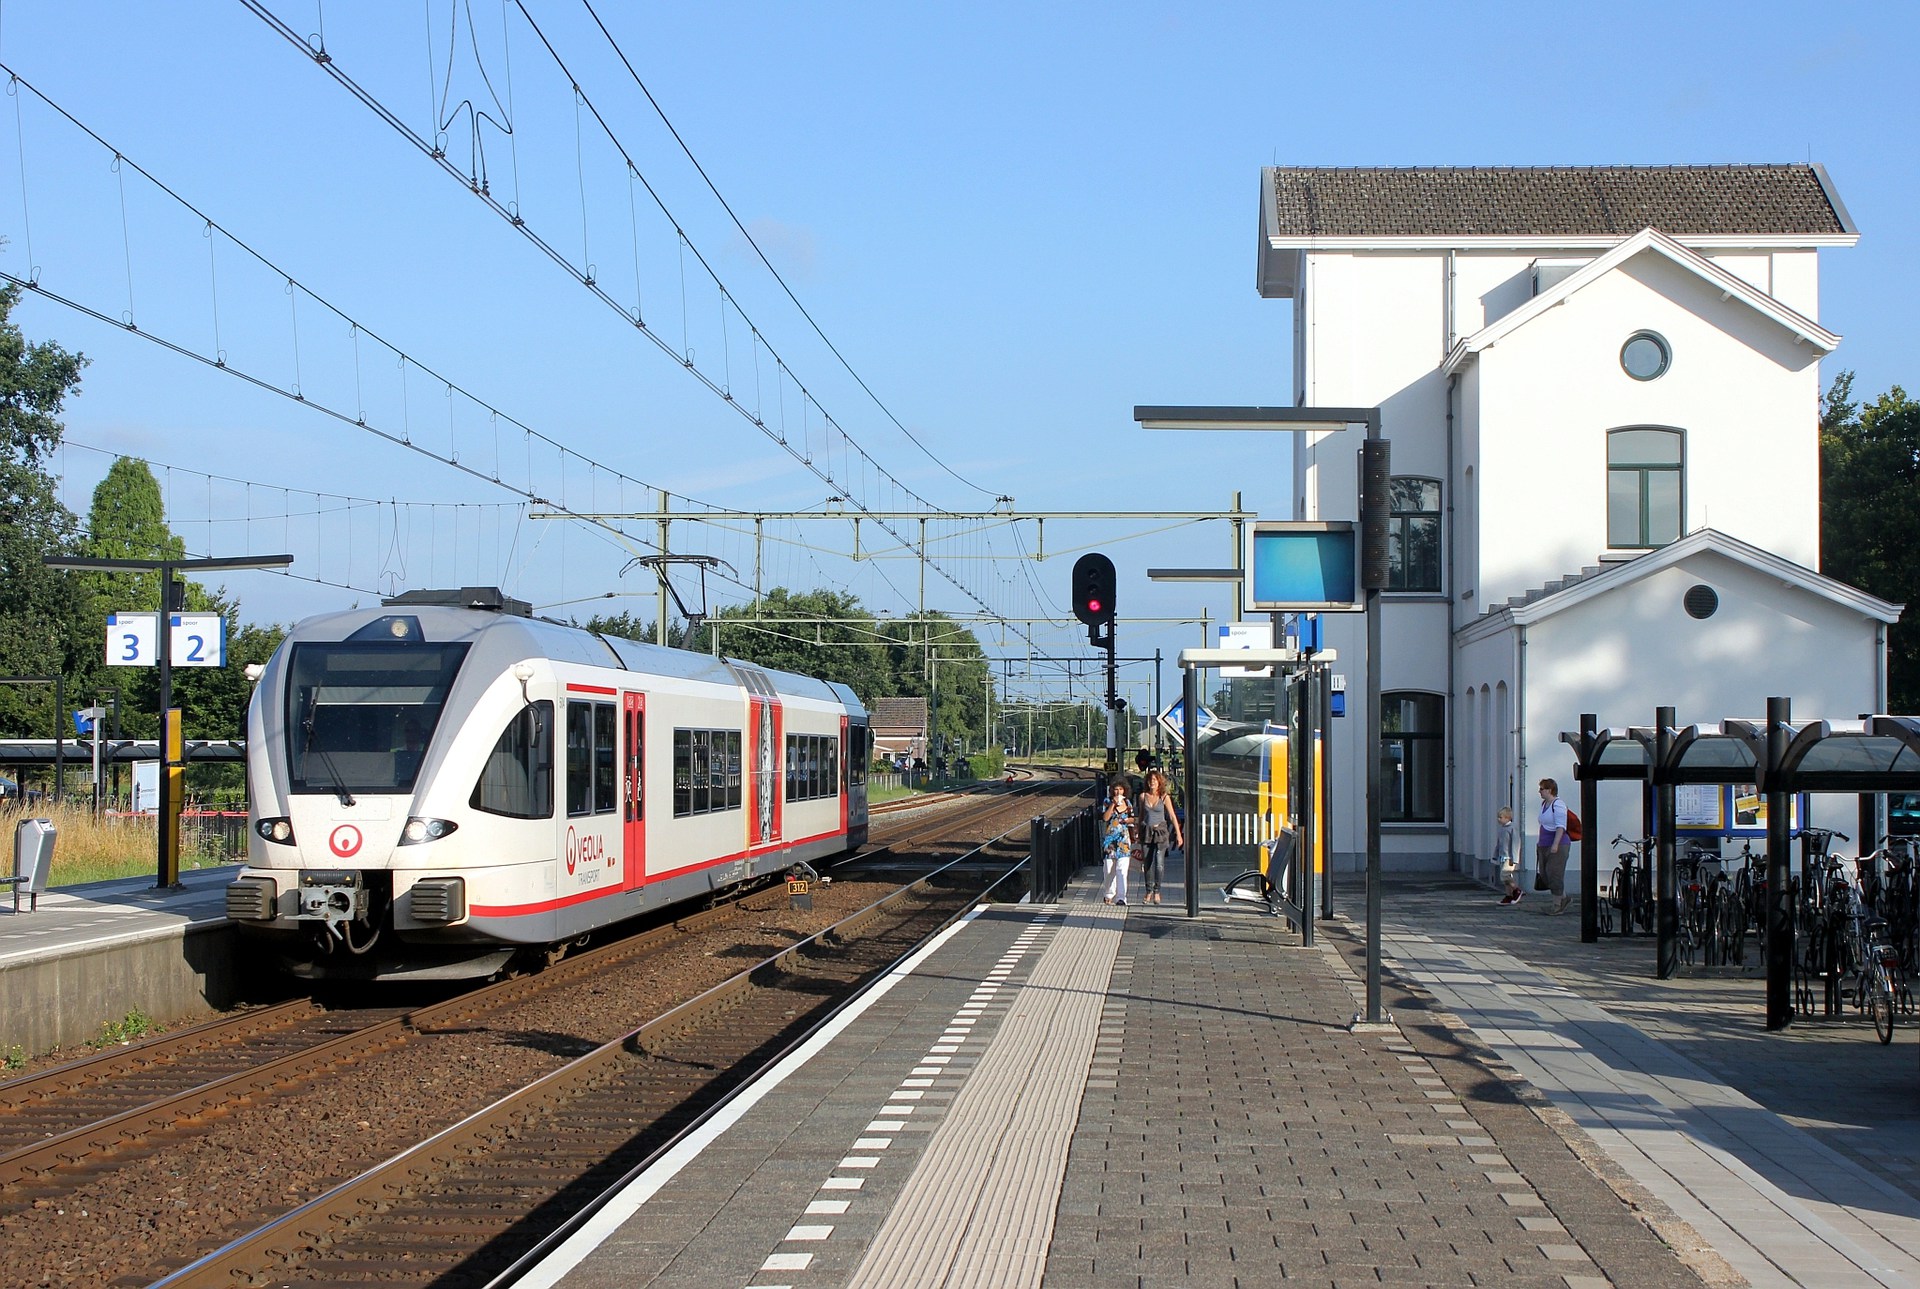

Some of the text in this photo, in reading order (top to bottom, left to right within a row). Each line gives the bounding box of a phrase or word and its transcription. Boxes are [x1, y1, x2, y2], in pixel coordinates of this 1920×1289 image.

[122, 633, 139, 661] 3
[187, 635, 204, 662] 2
[577, 834, 604, 863] VEOLIA
[792, 883, 806, 892] 312
